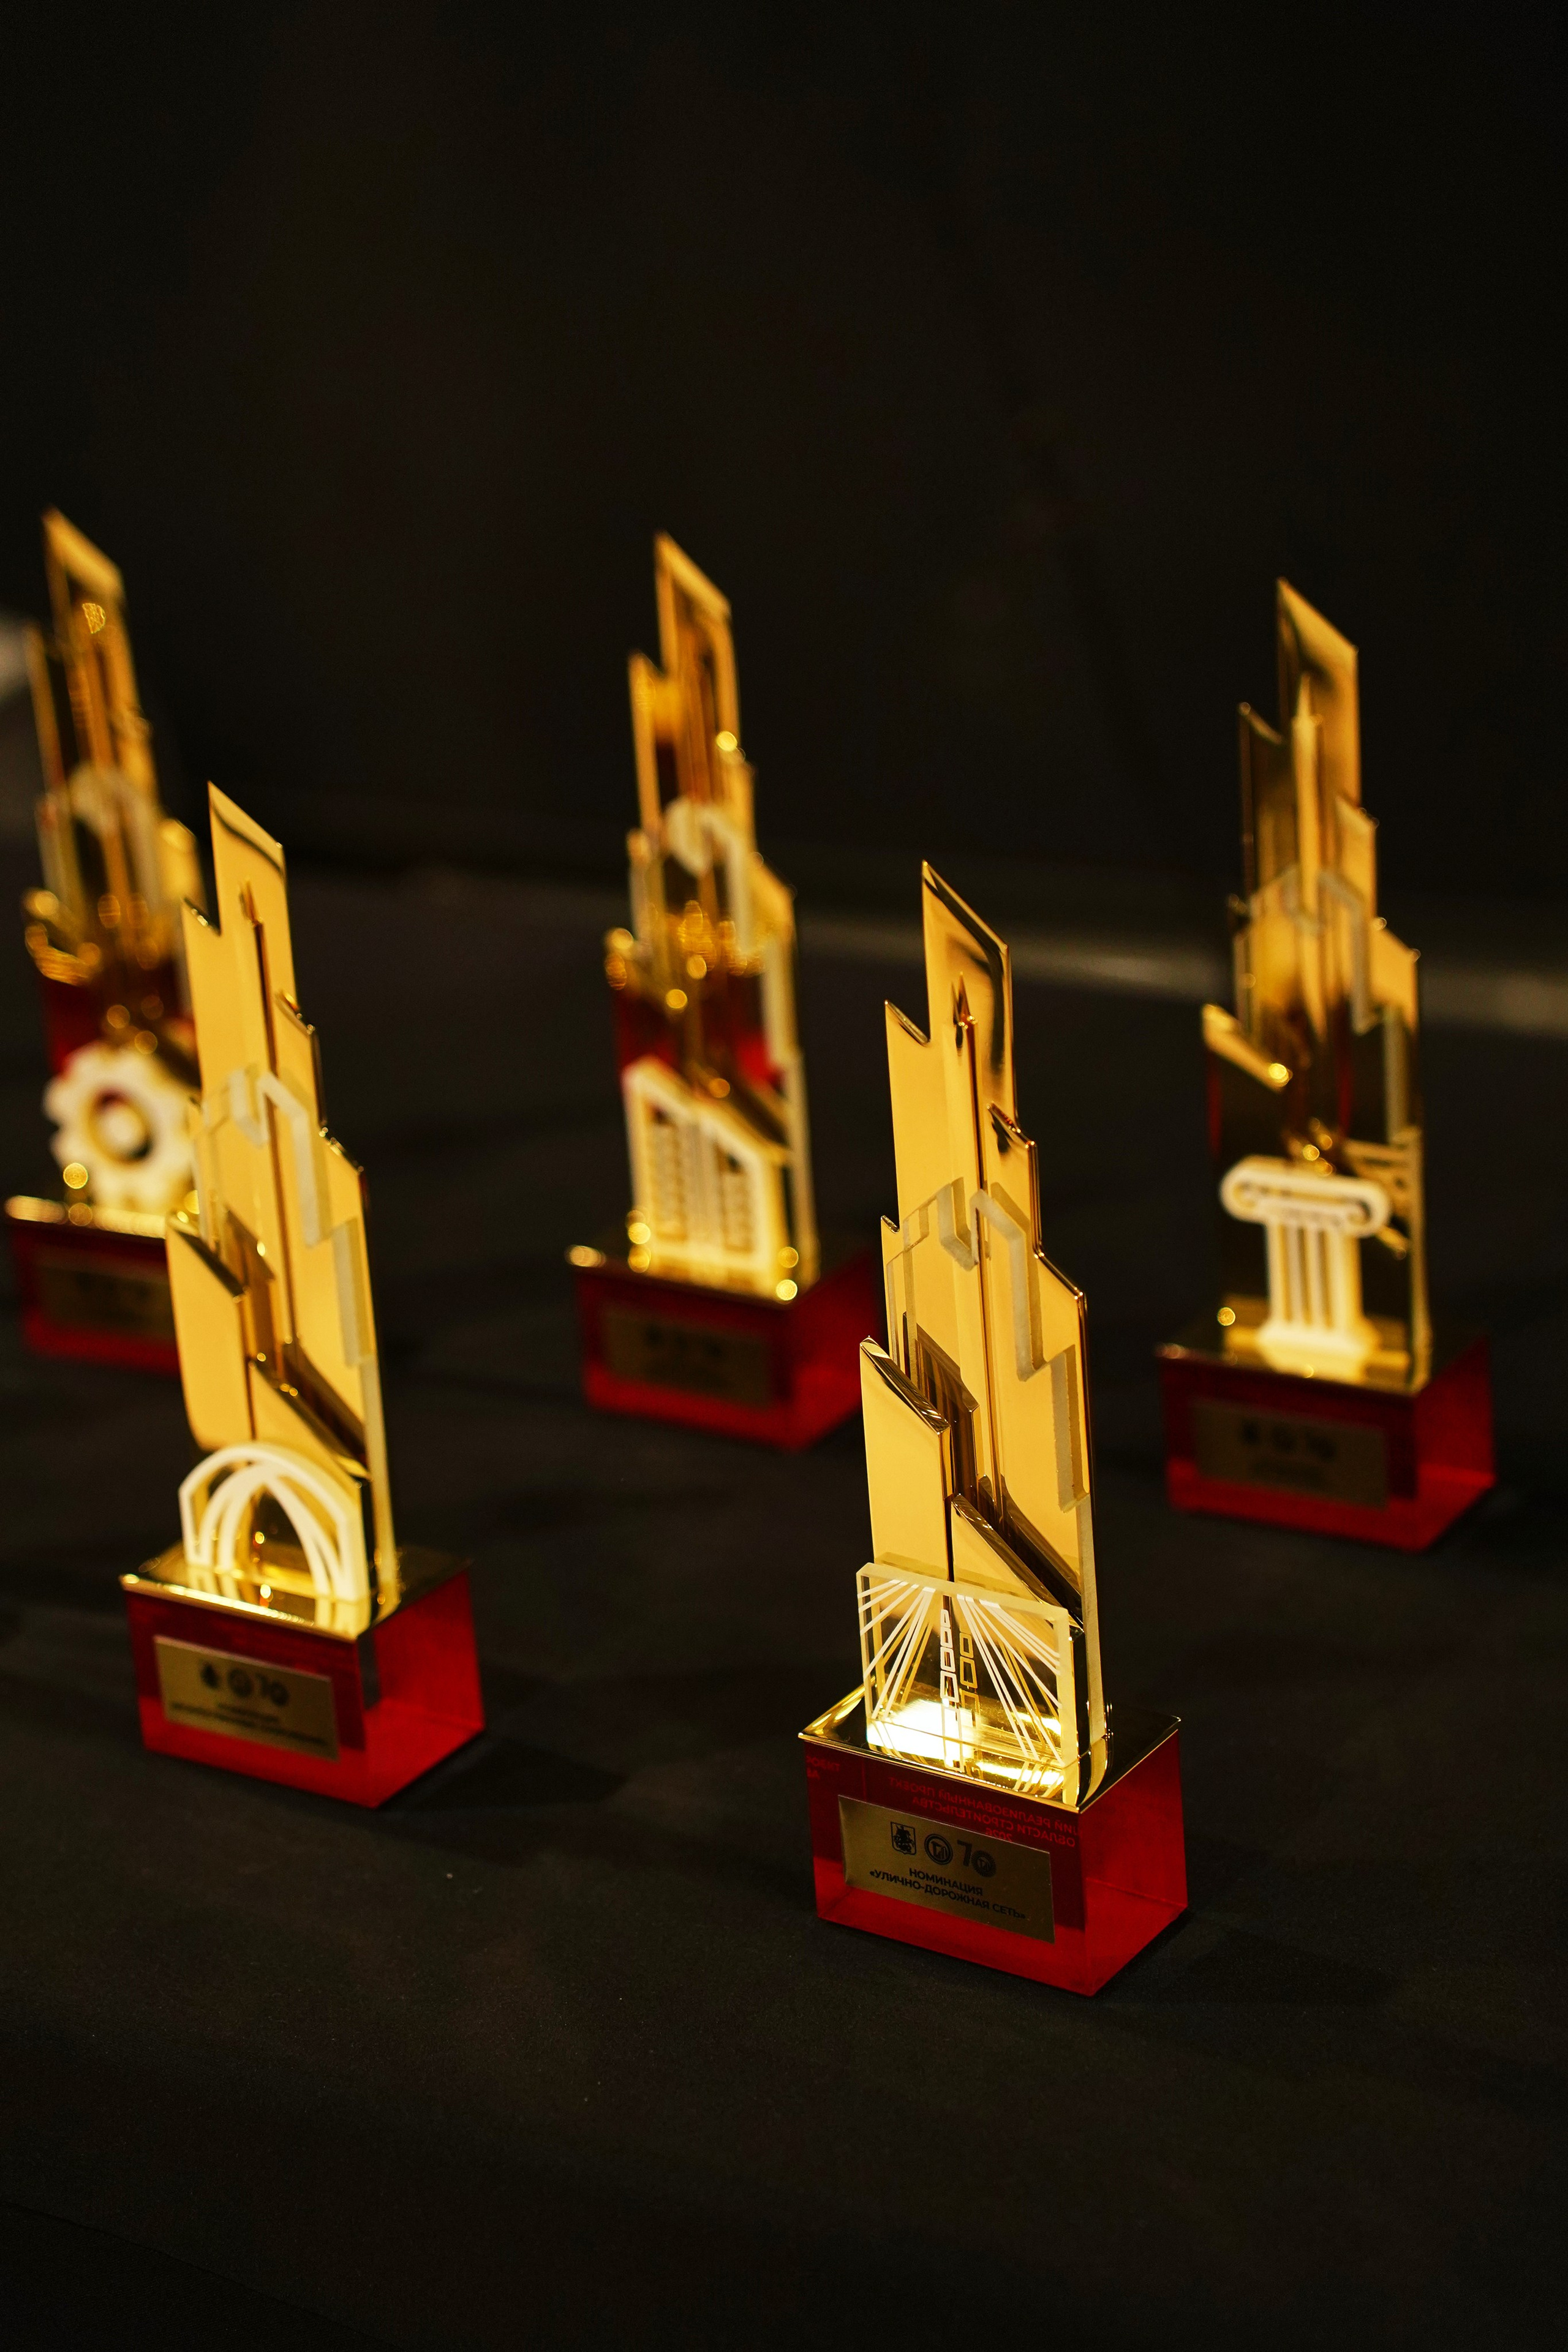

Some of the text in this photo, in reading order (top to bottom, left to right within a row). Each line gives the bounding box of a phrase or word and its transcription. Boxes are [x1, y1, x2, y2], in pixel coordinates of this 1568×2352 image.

[869, 1869, 1027, 1921] «УЛИЧНО-ДОРОЖНАЯ СЕТЬ»
[909, 1868, 983, 1896] НОМИНАЦИЯ
